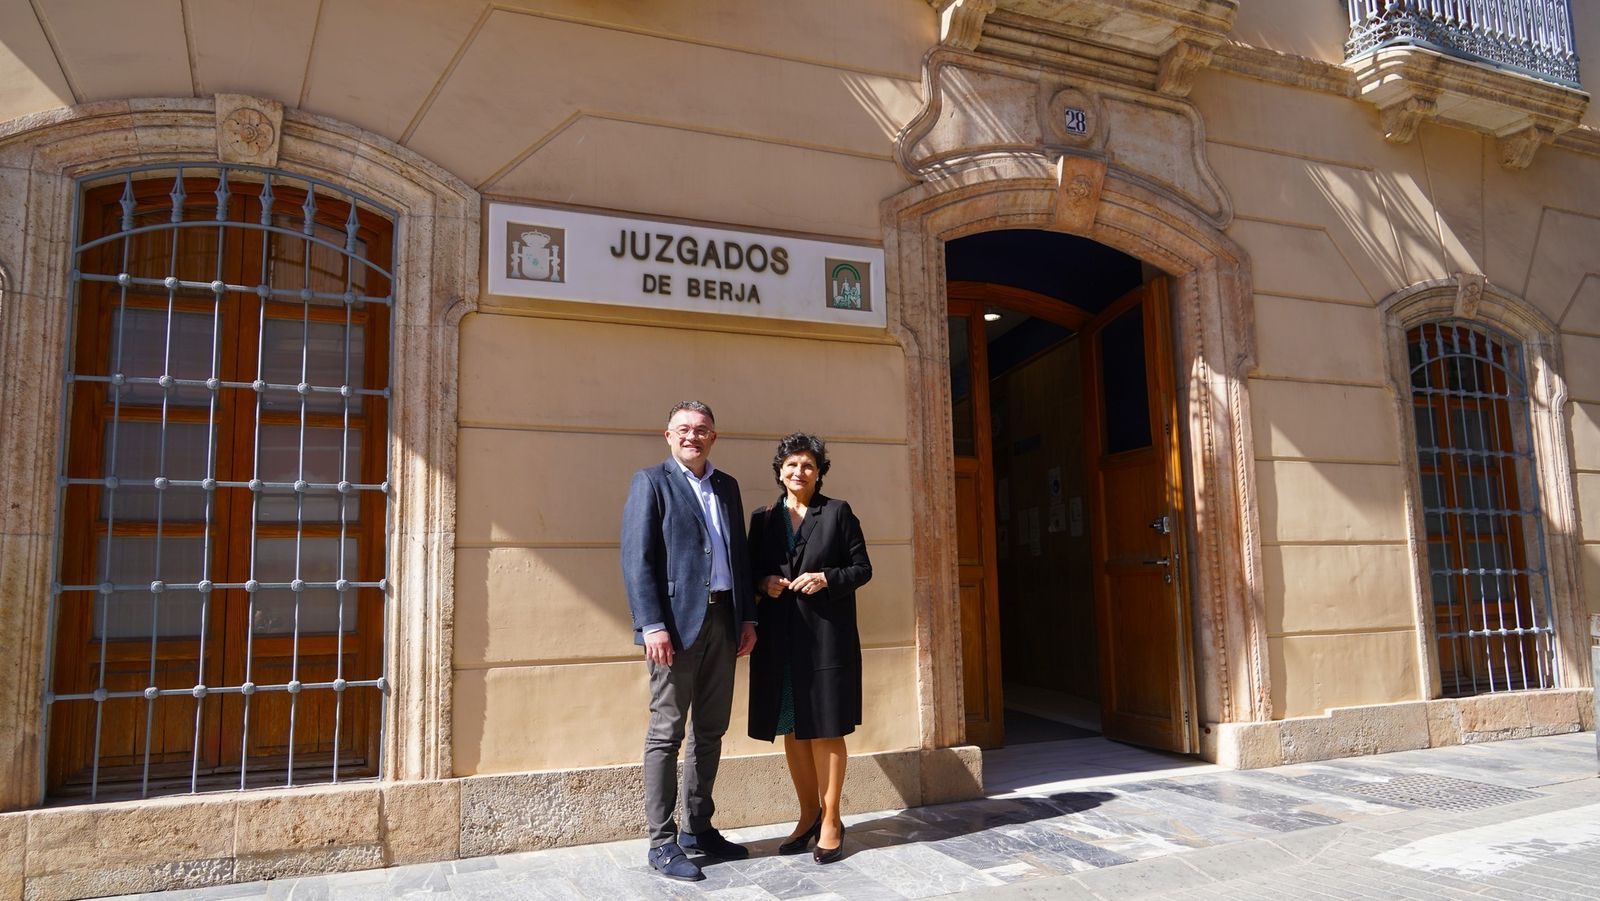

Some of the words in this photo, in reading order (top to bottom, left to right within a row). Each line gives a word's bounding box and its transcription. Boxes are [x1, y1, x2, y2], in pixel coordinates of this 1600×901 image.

[1065, 110, 1086, 132] 28
[610, 229, 789, 275] JUZGADOS
[642, 273, 672, 296] DE
[687, 278, 761, 304] BERJA
